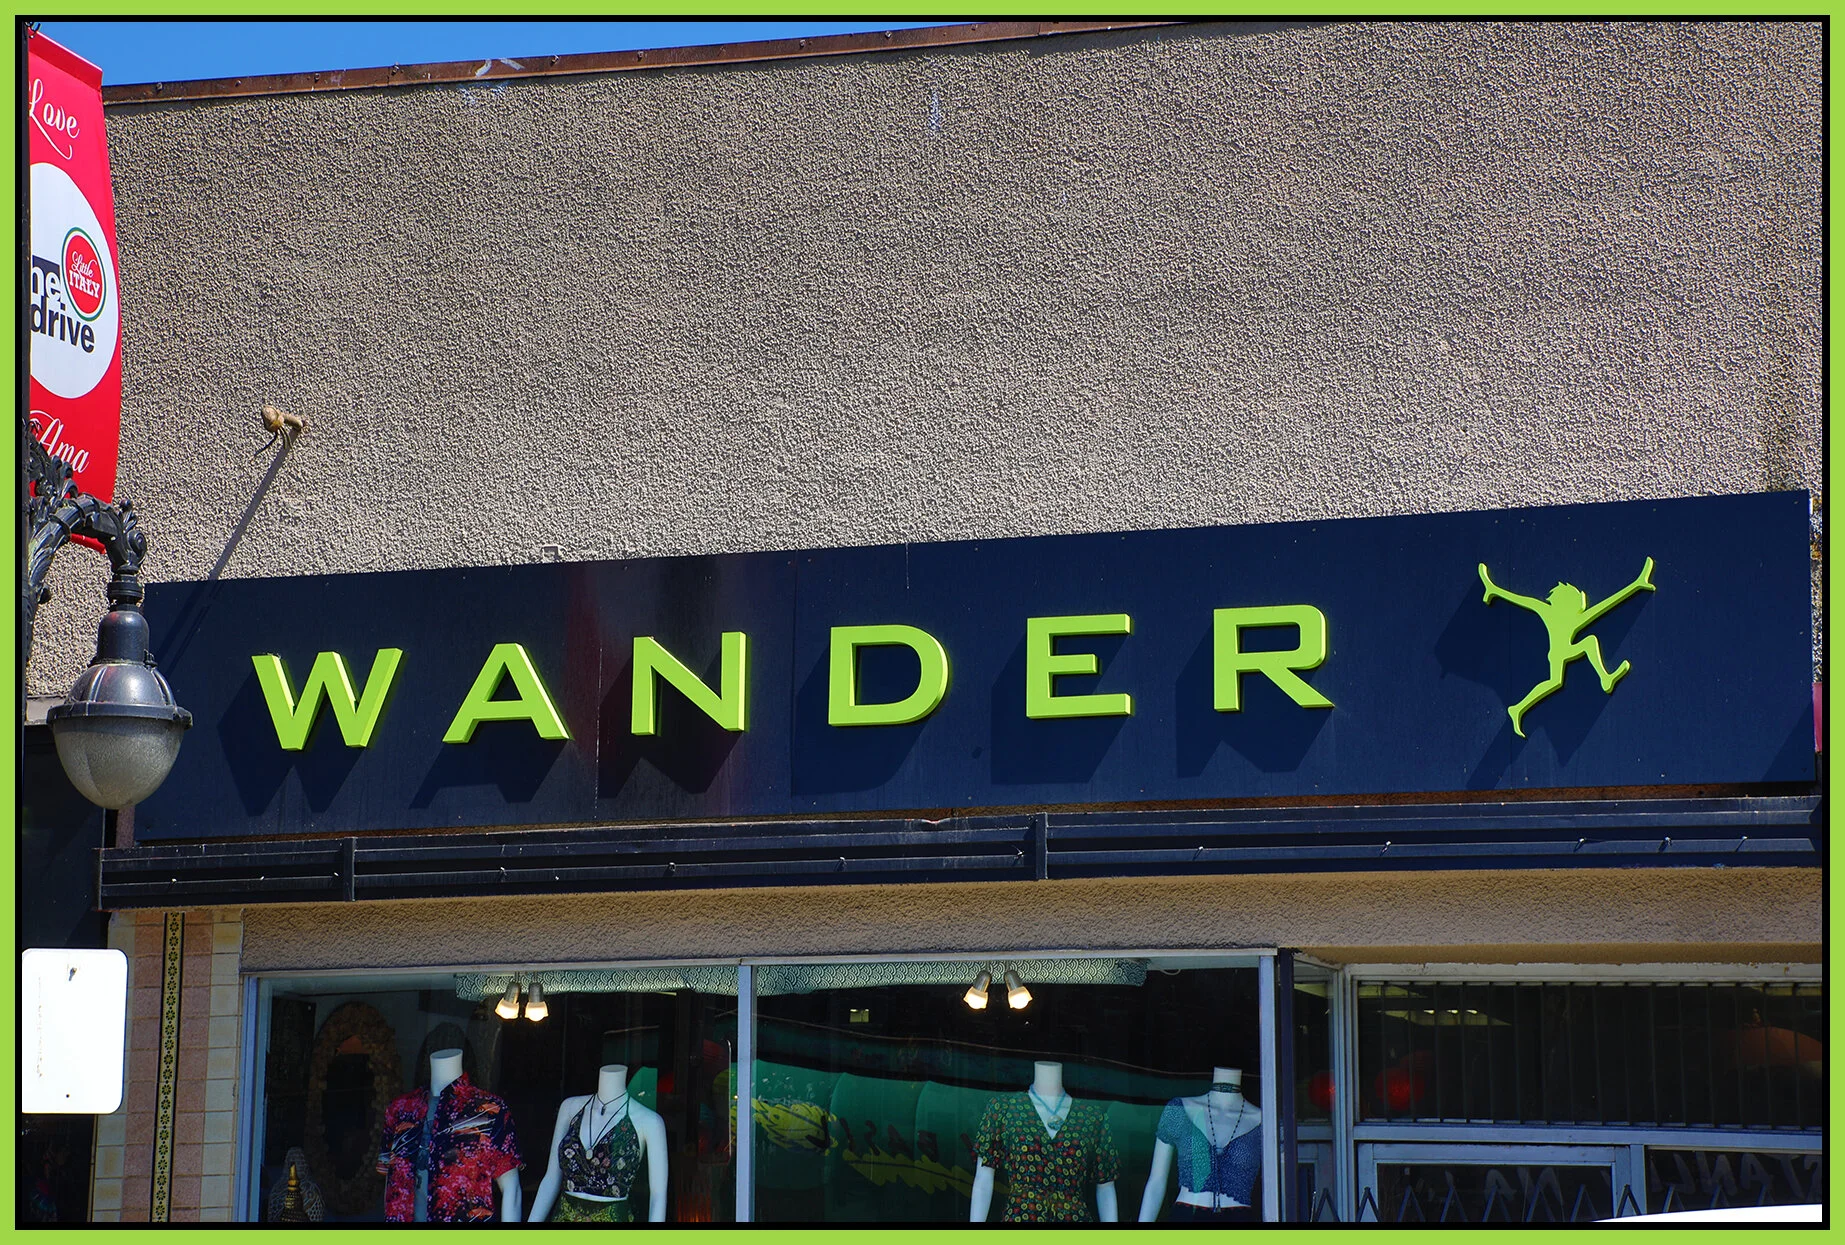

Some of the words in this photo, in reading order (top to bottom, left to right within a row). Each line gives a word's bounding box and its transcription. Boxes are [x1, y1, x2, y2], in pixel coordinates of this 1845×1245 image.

[29, 78, 80, 160] Love
[69, 270, 100, 298] ITALY
[72, 251, 98, 278] Little
[31, 295, 95, 353] drive
[252, 605, 1334, 751] WANDER
